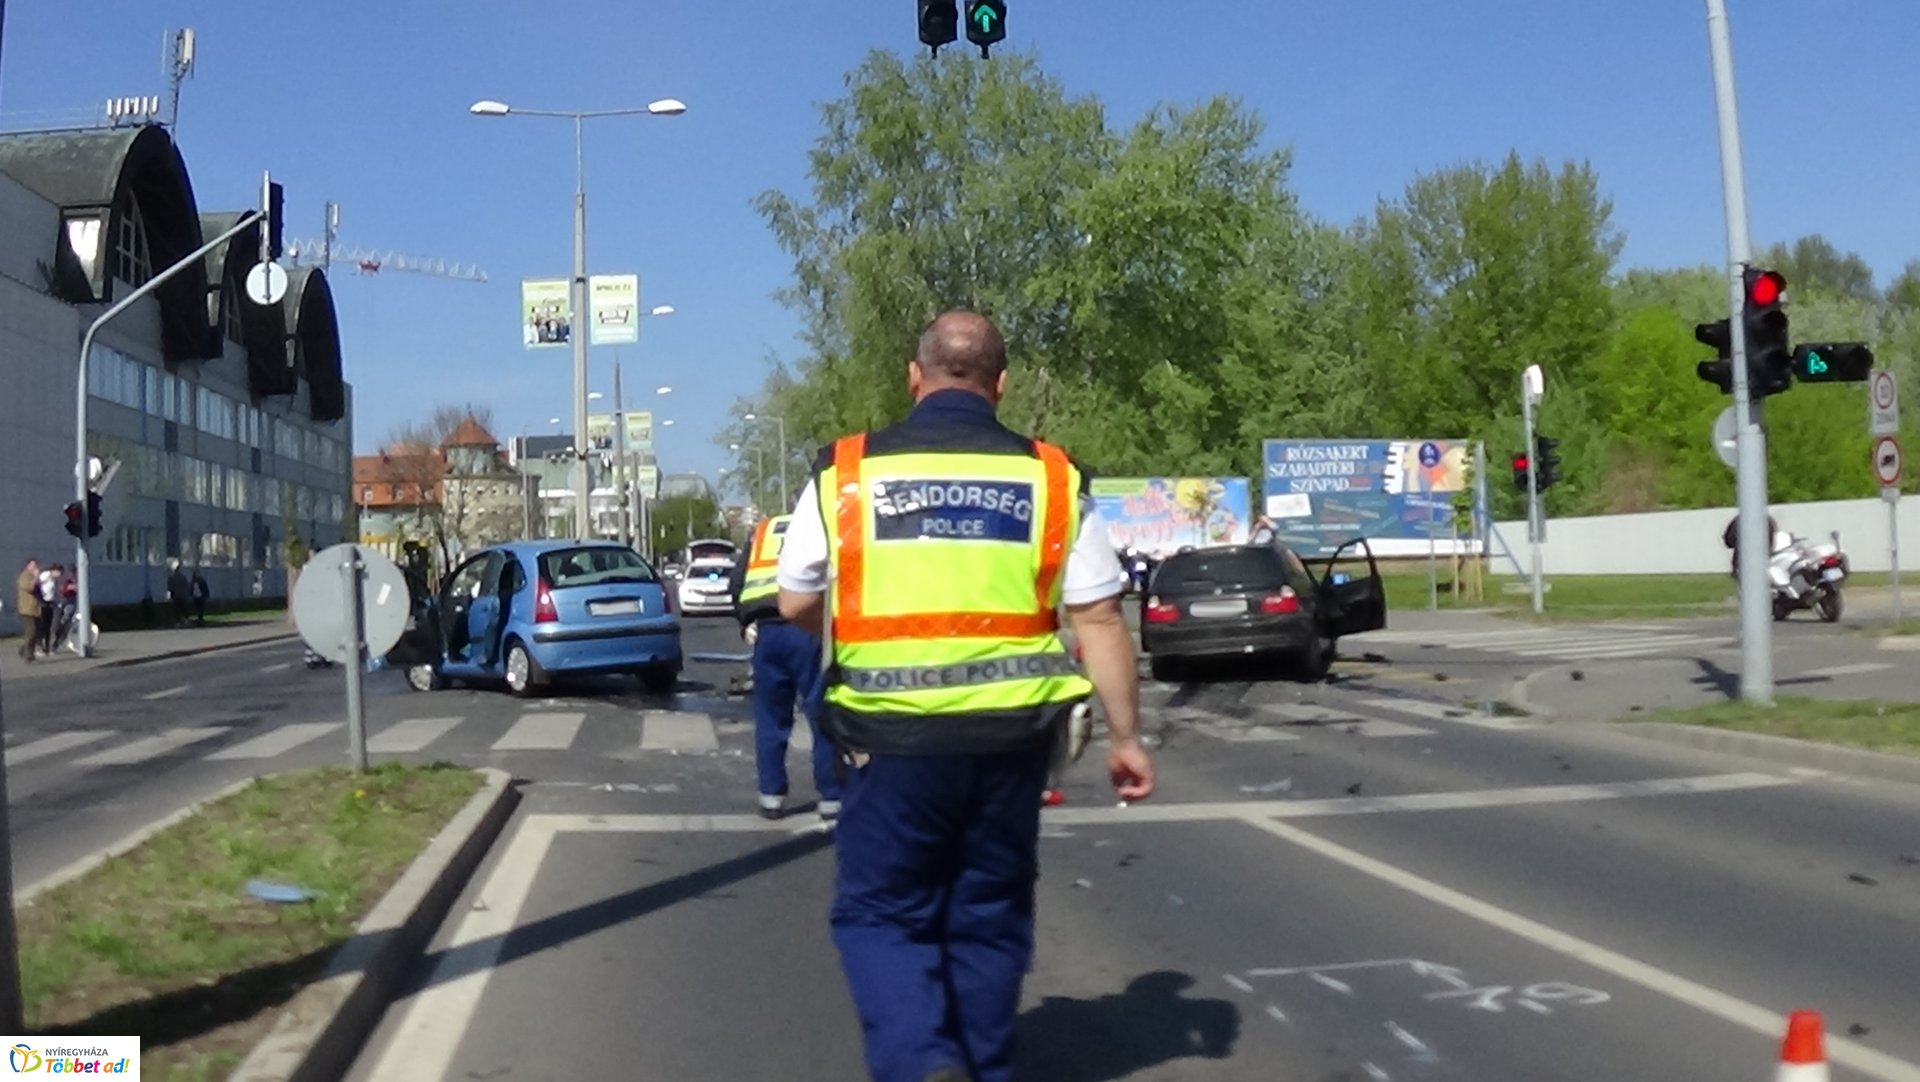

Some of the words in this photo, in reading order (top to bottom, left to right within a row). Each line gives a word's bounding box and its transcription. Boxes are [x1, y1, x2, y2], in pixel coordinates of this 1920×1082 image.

[1286, 444, 1369, 461] RÓZSAKERT
[1268, 460, 1355, 477] SZABADTÉRI
[1289, 476, 1350, 493] SZÍNPAD
[922, 518, 985, 535] POLICE
[859, 669, 951, 688] POLICE
[966, 656, 1048, 676] POLIC
